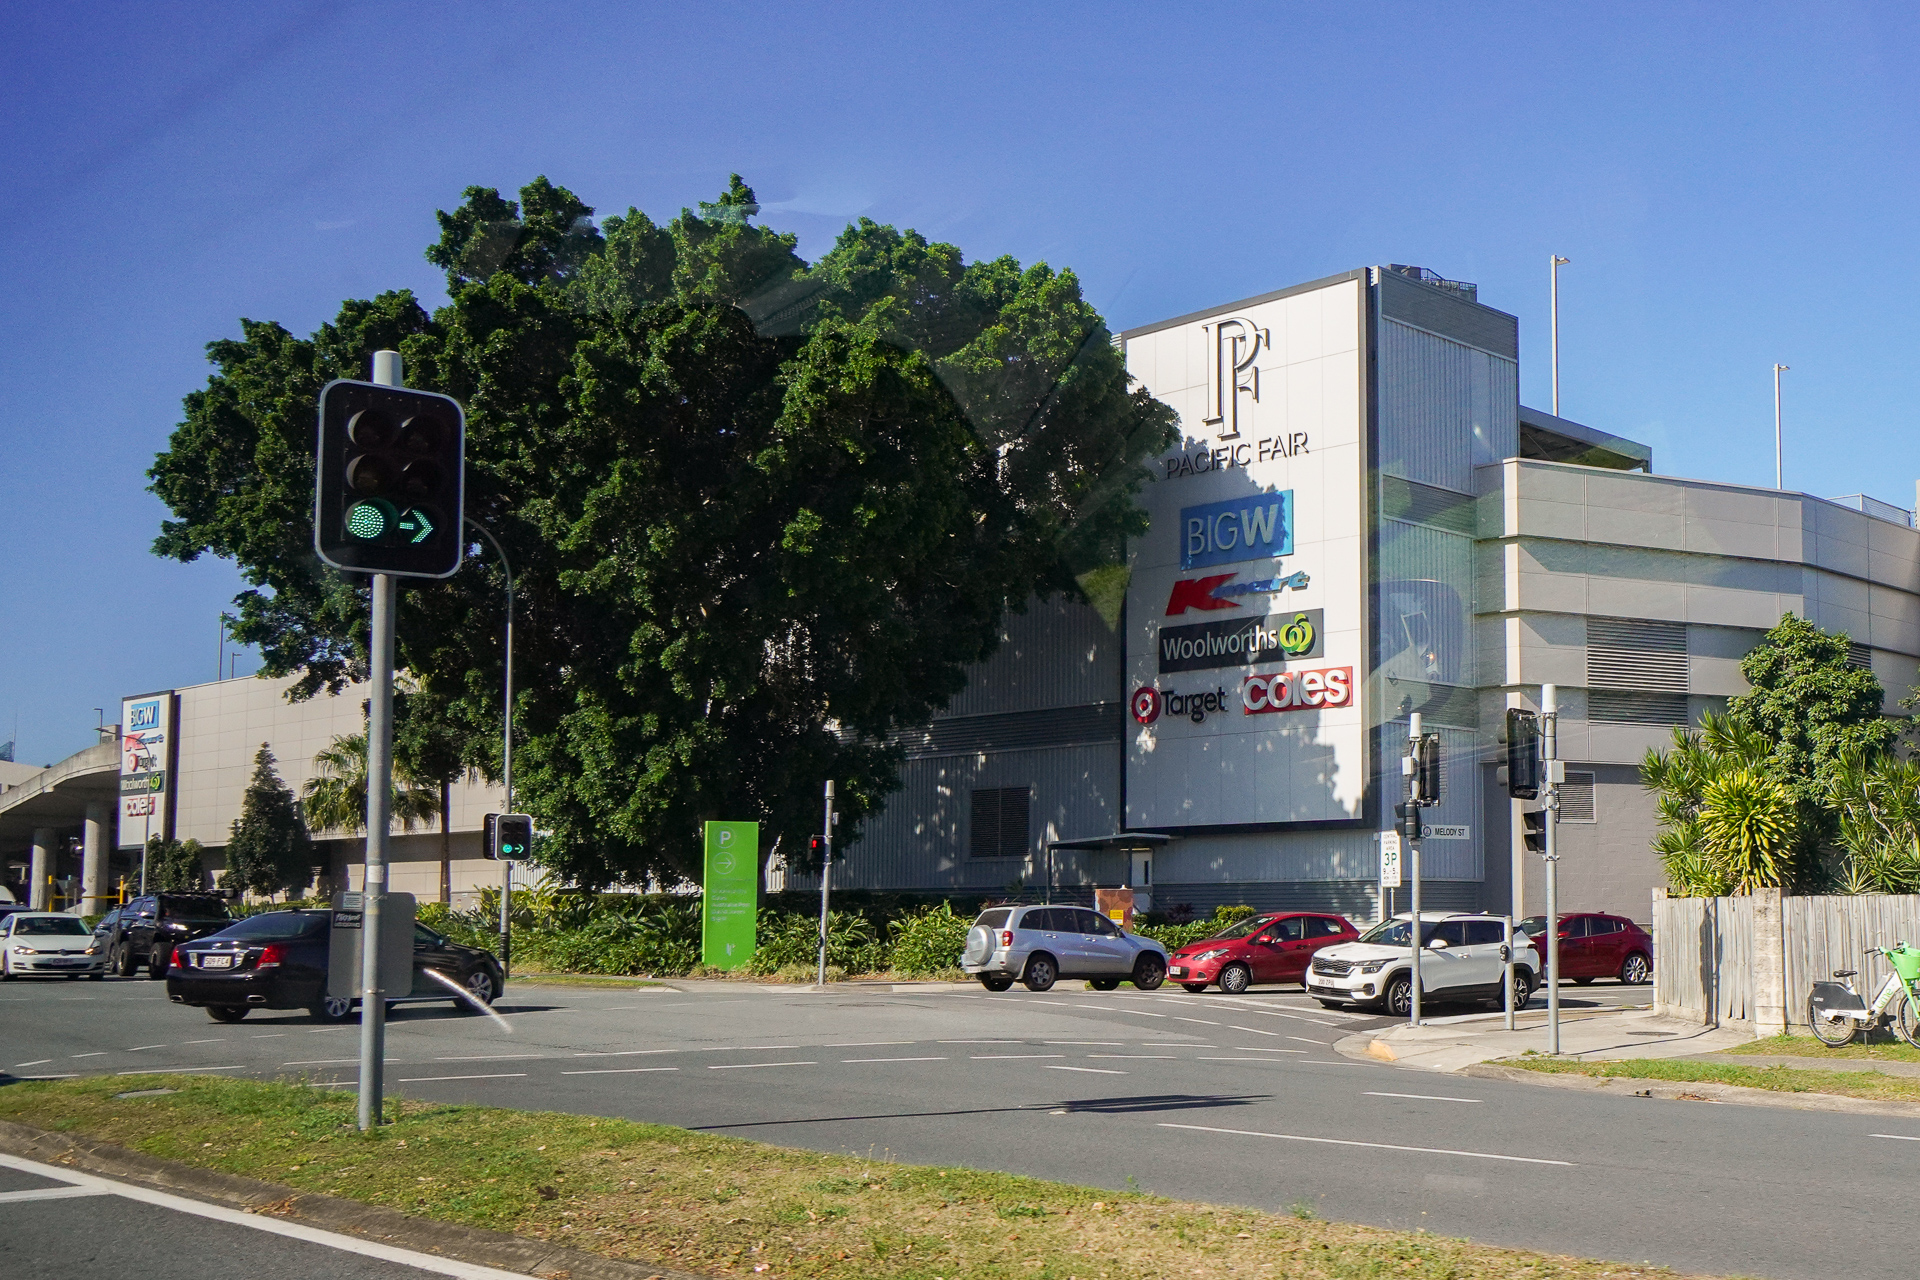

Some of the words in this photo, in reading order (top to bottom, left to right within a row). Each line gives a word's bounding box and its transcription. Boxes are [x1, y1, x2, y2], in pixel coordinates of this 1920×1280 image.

[1166, 442, 1252, 479] PACIFIC
[1258, 431, 1310, 463] FAIR
[1162, 624, 1278, 661] Woolworths
[1242, 668, 1349, 711] coles
[1161, 686, 1229, 723] Target
[719, 831, 731, 845] P
[1435, 828, 1457, 836] MELODY
[1458, 828, 1465, 836] ST
[1384, 852, 1397, 866] 3P
[1876, 988, 1894, 1009] Lime
